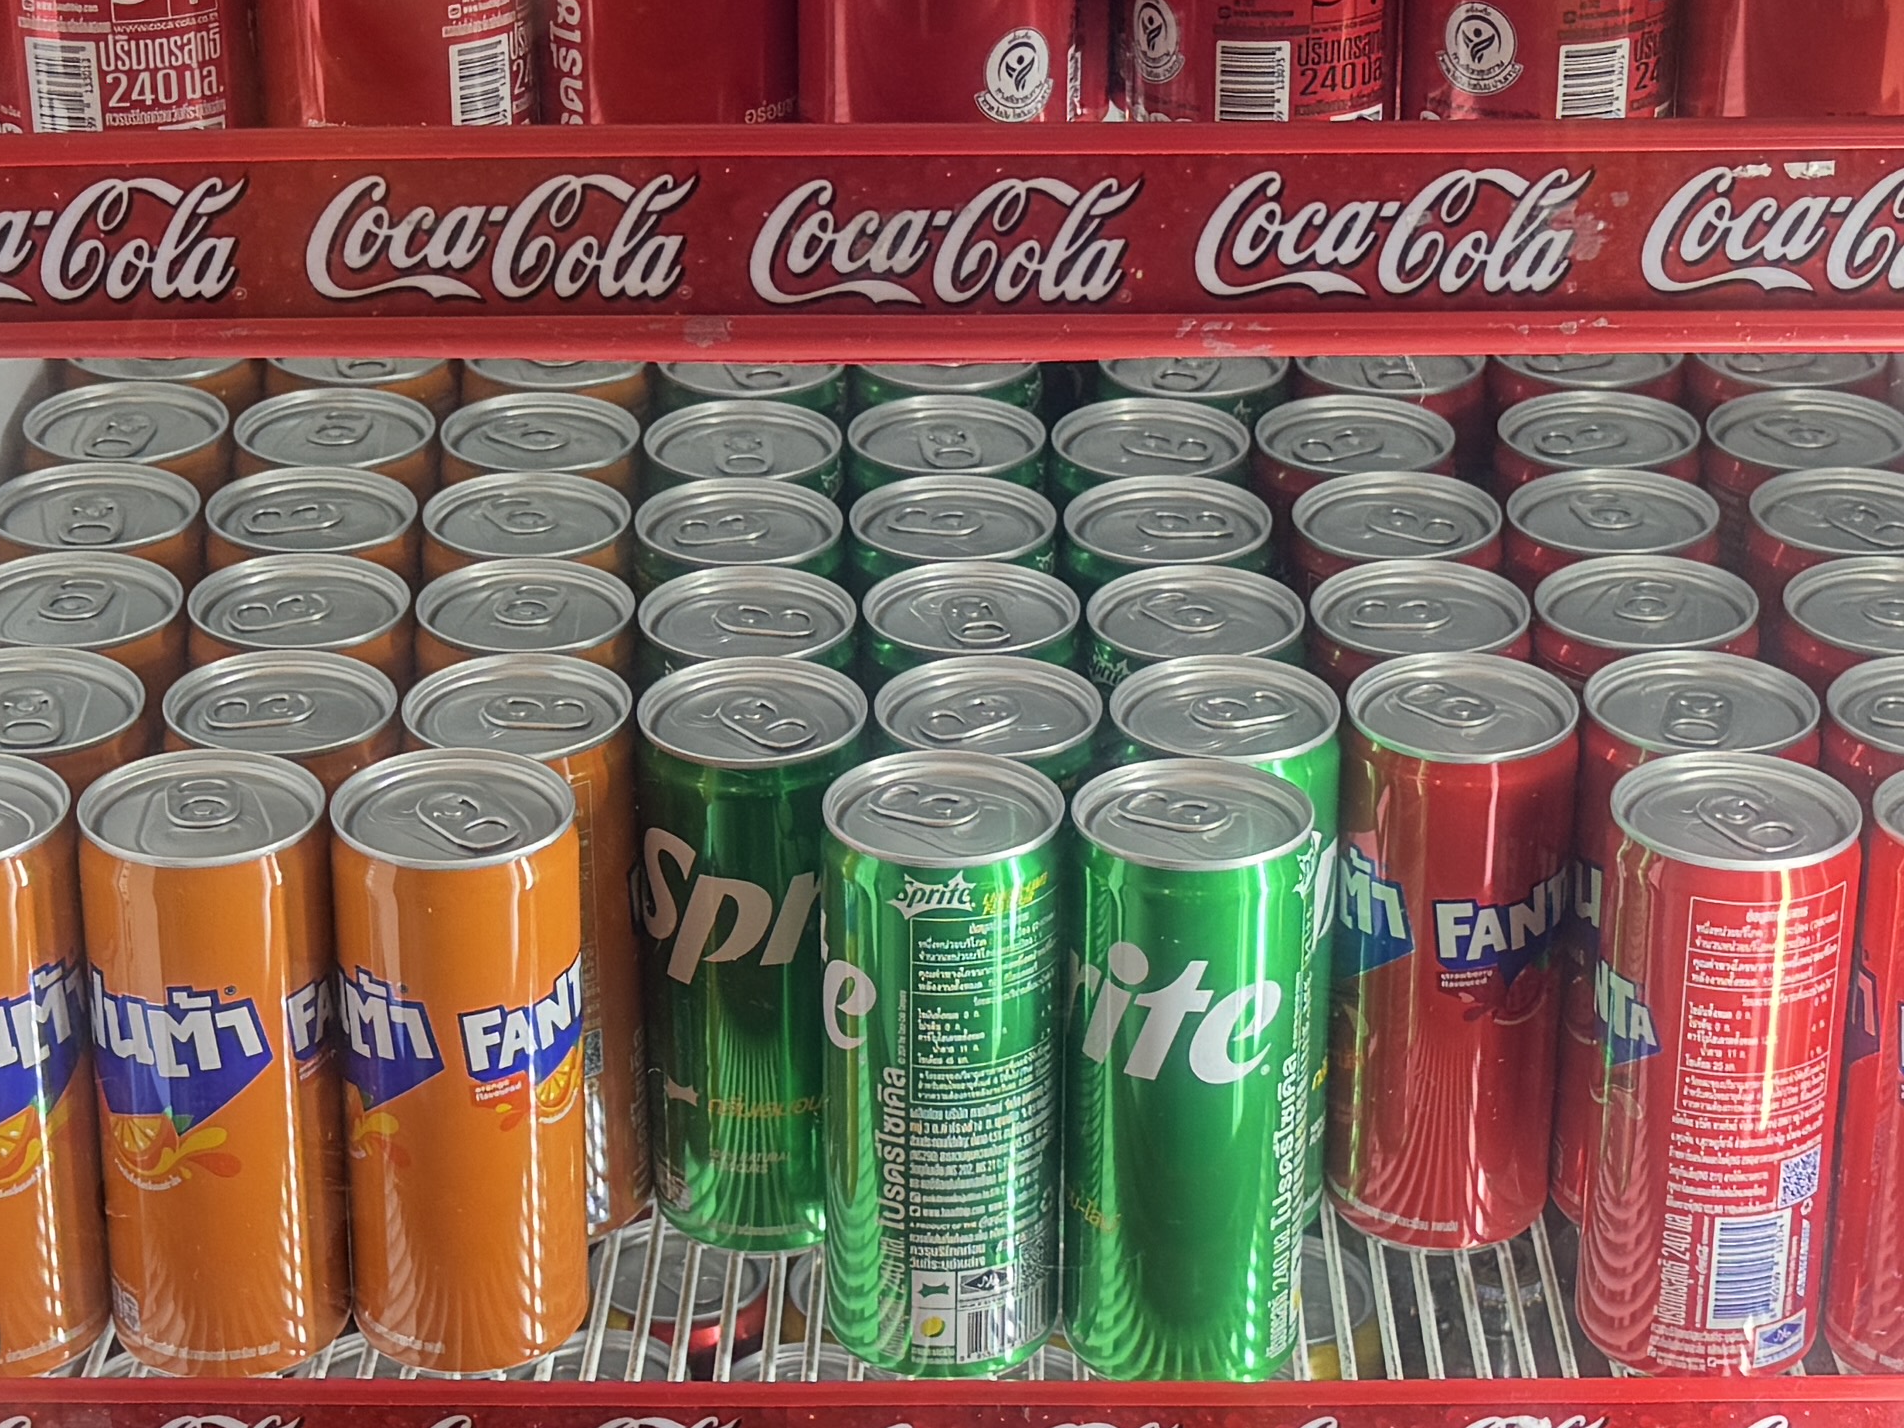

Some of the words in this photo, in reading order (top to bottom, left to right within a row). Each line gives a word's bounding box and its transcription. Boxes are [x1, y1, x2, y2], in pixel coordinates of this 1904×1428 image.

[99, 23, 222, 72] ปริมาตรสุทธิ
[106, 67, 178, 108] 240
[185, 65, 225, 100] มล.
[1300, 64, 1356, 97] 240
[306, 174, 695, 299] Coca-Cola
[750, 177, 1140, 303] Coca-Cola
[1195, 168, 1593, 295] Coca-Cola
[897, 880, 972, 908] Sprite
[875, 1066, 907, 1230] โปรดรีไซเคิล
[1270, 1053, 1298, 1231] โปรดรีไซเคิล
[1660, 1230, 1692, 1261] 240
